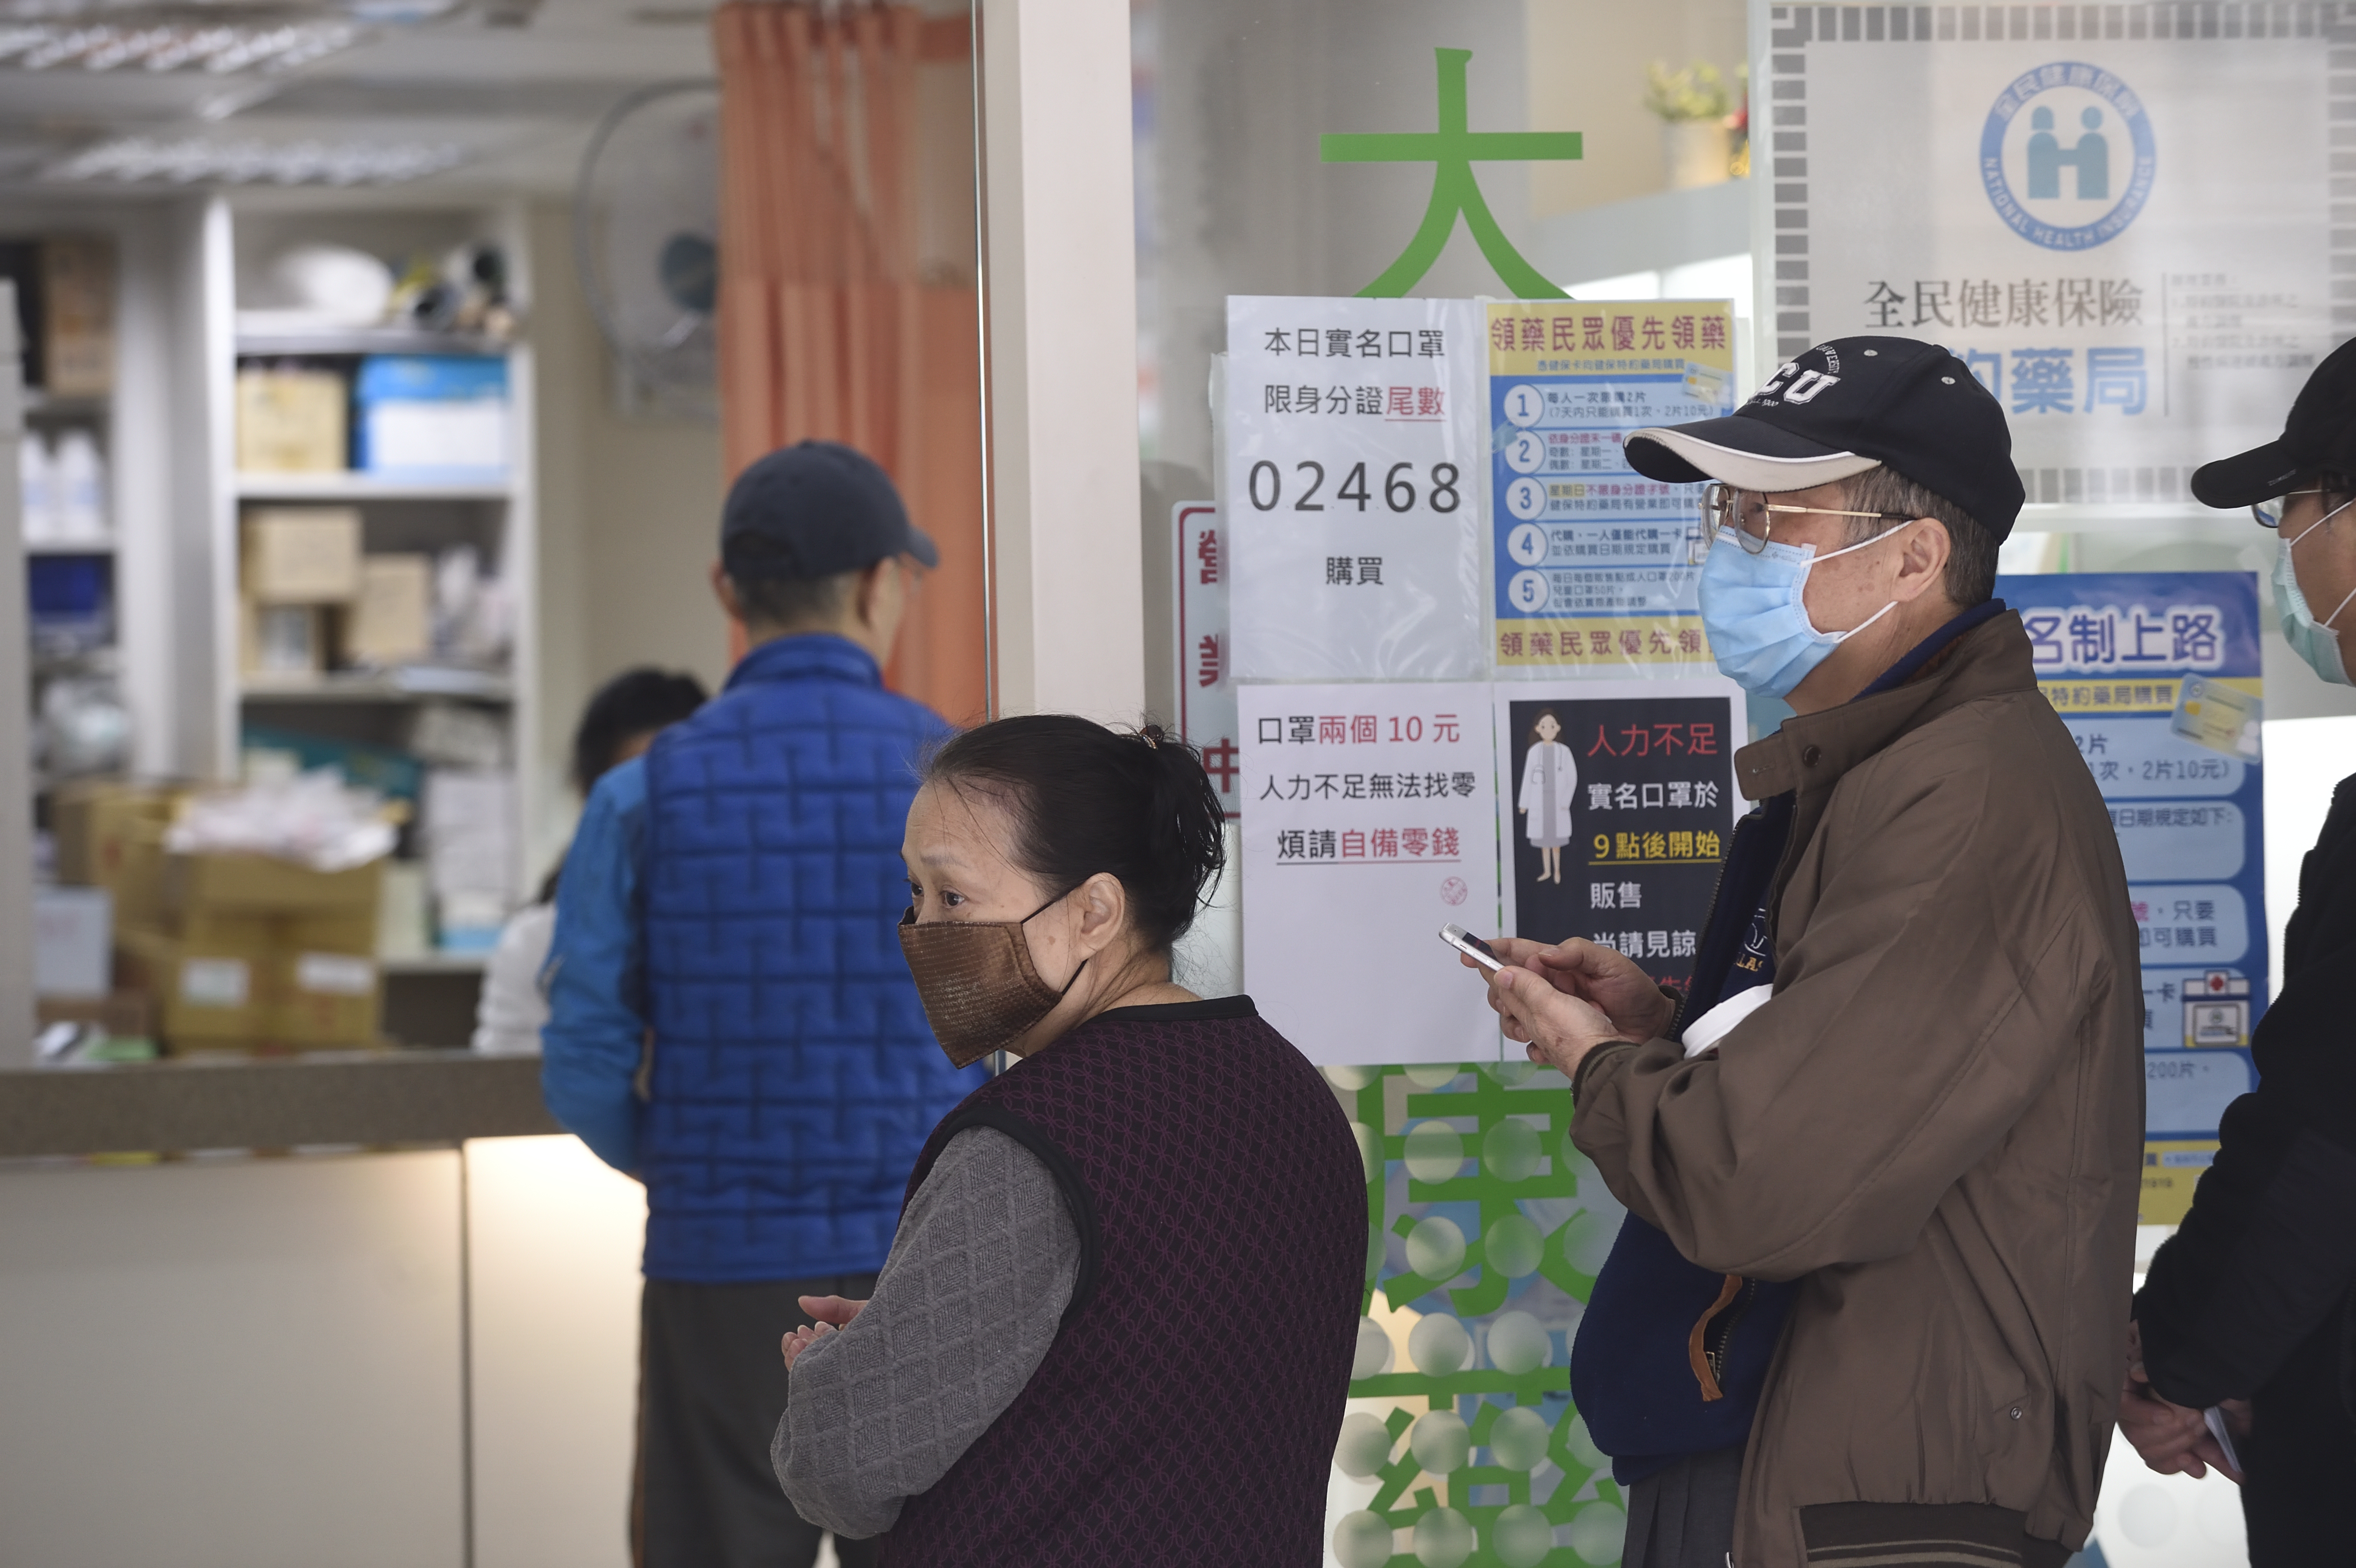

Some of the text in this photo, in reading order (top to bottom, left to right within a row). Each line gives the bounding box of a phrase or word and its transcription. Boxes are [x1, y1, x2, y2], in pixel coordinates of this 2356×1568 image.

[1320, 47, 1583, 299] 大
[1984, 157, 2029, 233] NATIONAL
[2033, 227, 2095, 248] HEALTH
[1865, 279, 2144, 328] 全民健康保險
[1265, 327, 1445, 358] 本日實名口罩
[1492, 316, 1725, 352] 領藥民眾優先領藥
[1264, 385, 1445, 415] 限身分證尾數
[1517, 394, 1528, 416] 1
[1519, 440, 1530, 462] 2
[1249, 460, 1460, 513] 02468
[1520, 487, 1531, 510] 3
[1549, 499, 1701, 511] 健保特約藥局有營業即可購
[1521, 533, 1533, 555] 4
[1326, 557, 1384, 585] 購買
[1522, 579, 1534, 602] 5
[1501, 630, 1712, 656] 領藥民眾優先領
[2025, 614, 2217, 664] 名制上路
[1259, 714, 1460, 744] 口罩兩個 10 元
[1588, 723, 1717, 757] 人力不足
[1260, 772, 1475, 801] 人力不足無法找零
[1588, 780, 1718, 811] 實名口罩於
[1278, 828, 1460, 859] 煩請自備零錢
[1594, 831, 1720, 859] 9點後開始
[1591, 882, 1641, 909] 販售
